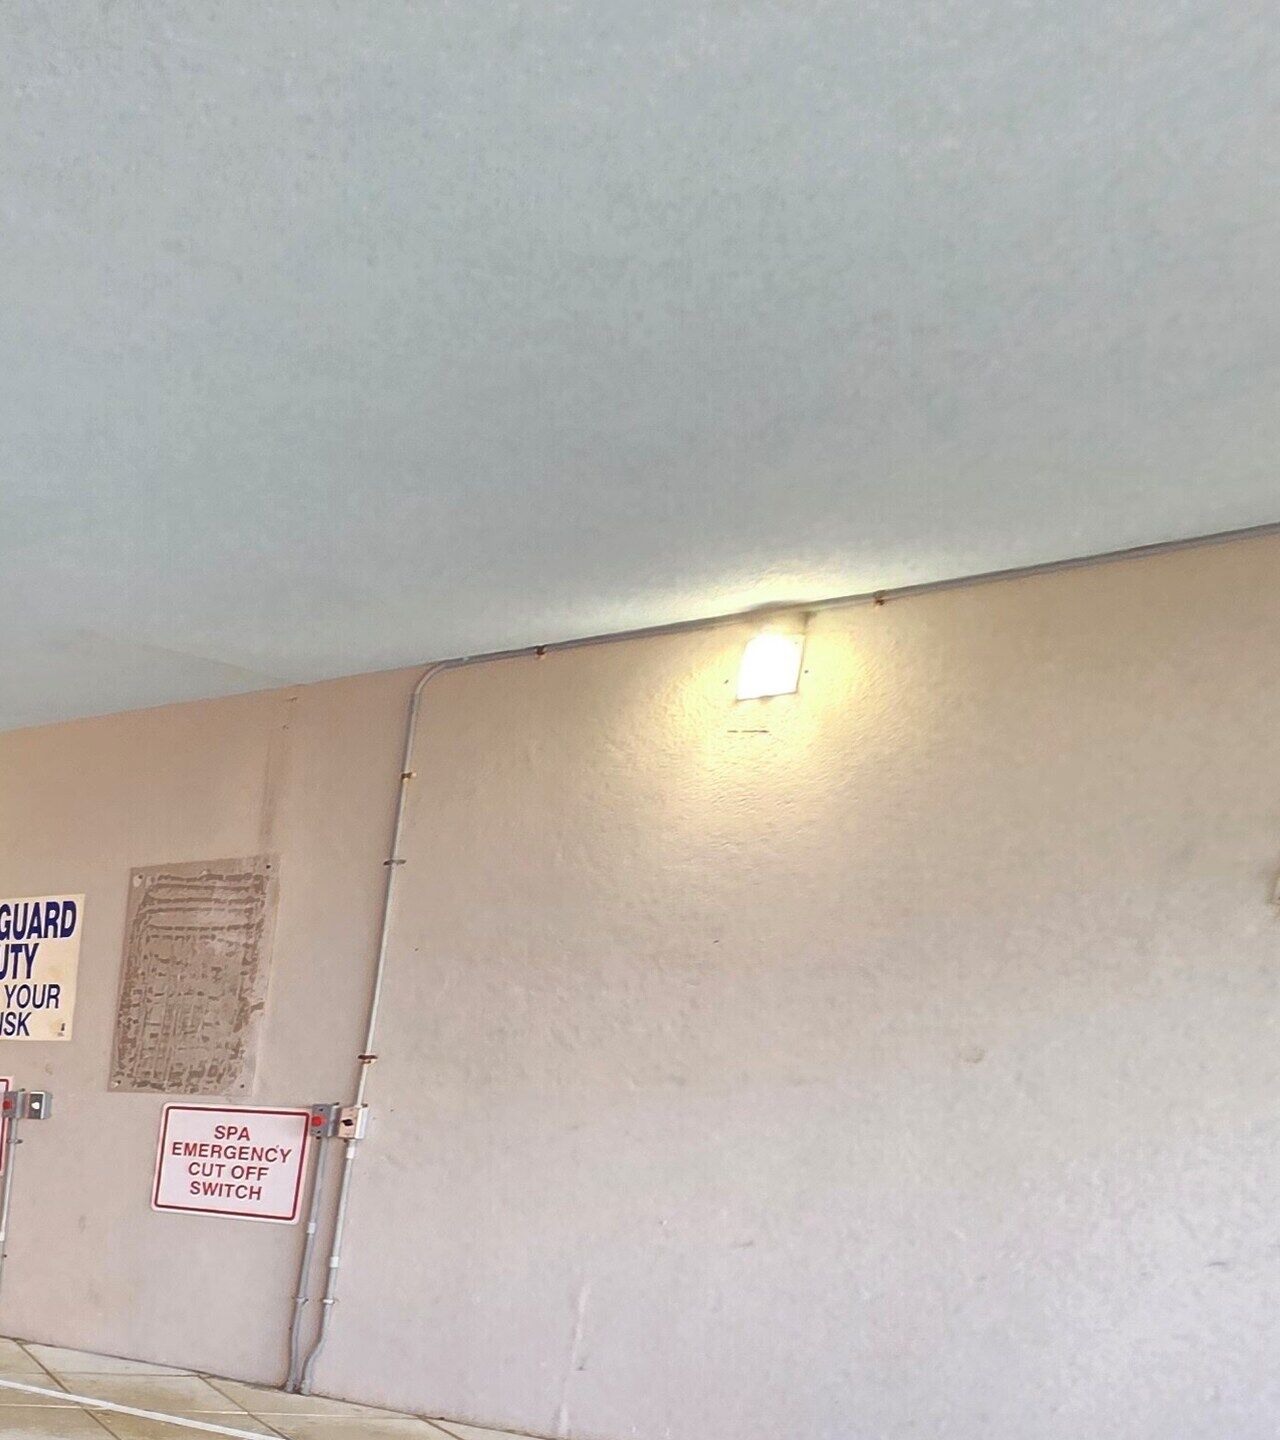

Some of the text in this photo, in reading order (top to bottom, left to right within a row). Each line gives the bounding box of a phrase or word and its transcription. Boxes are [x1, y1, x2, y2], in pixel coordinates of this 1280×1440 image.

[4, 984, 61, 1009] YOUR
[214, 1125, 250, 1141] SPA
[172, 1142, 291, 1164] EMERGENCY
[188, 1162, 269, 1181] CUT OFF
[190, 1181, 263, 1200] SWITCH
